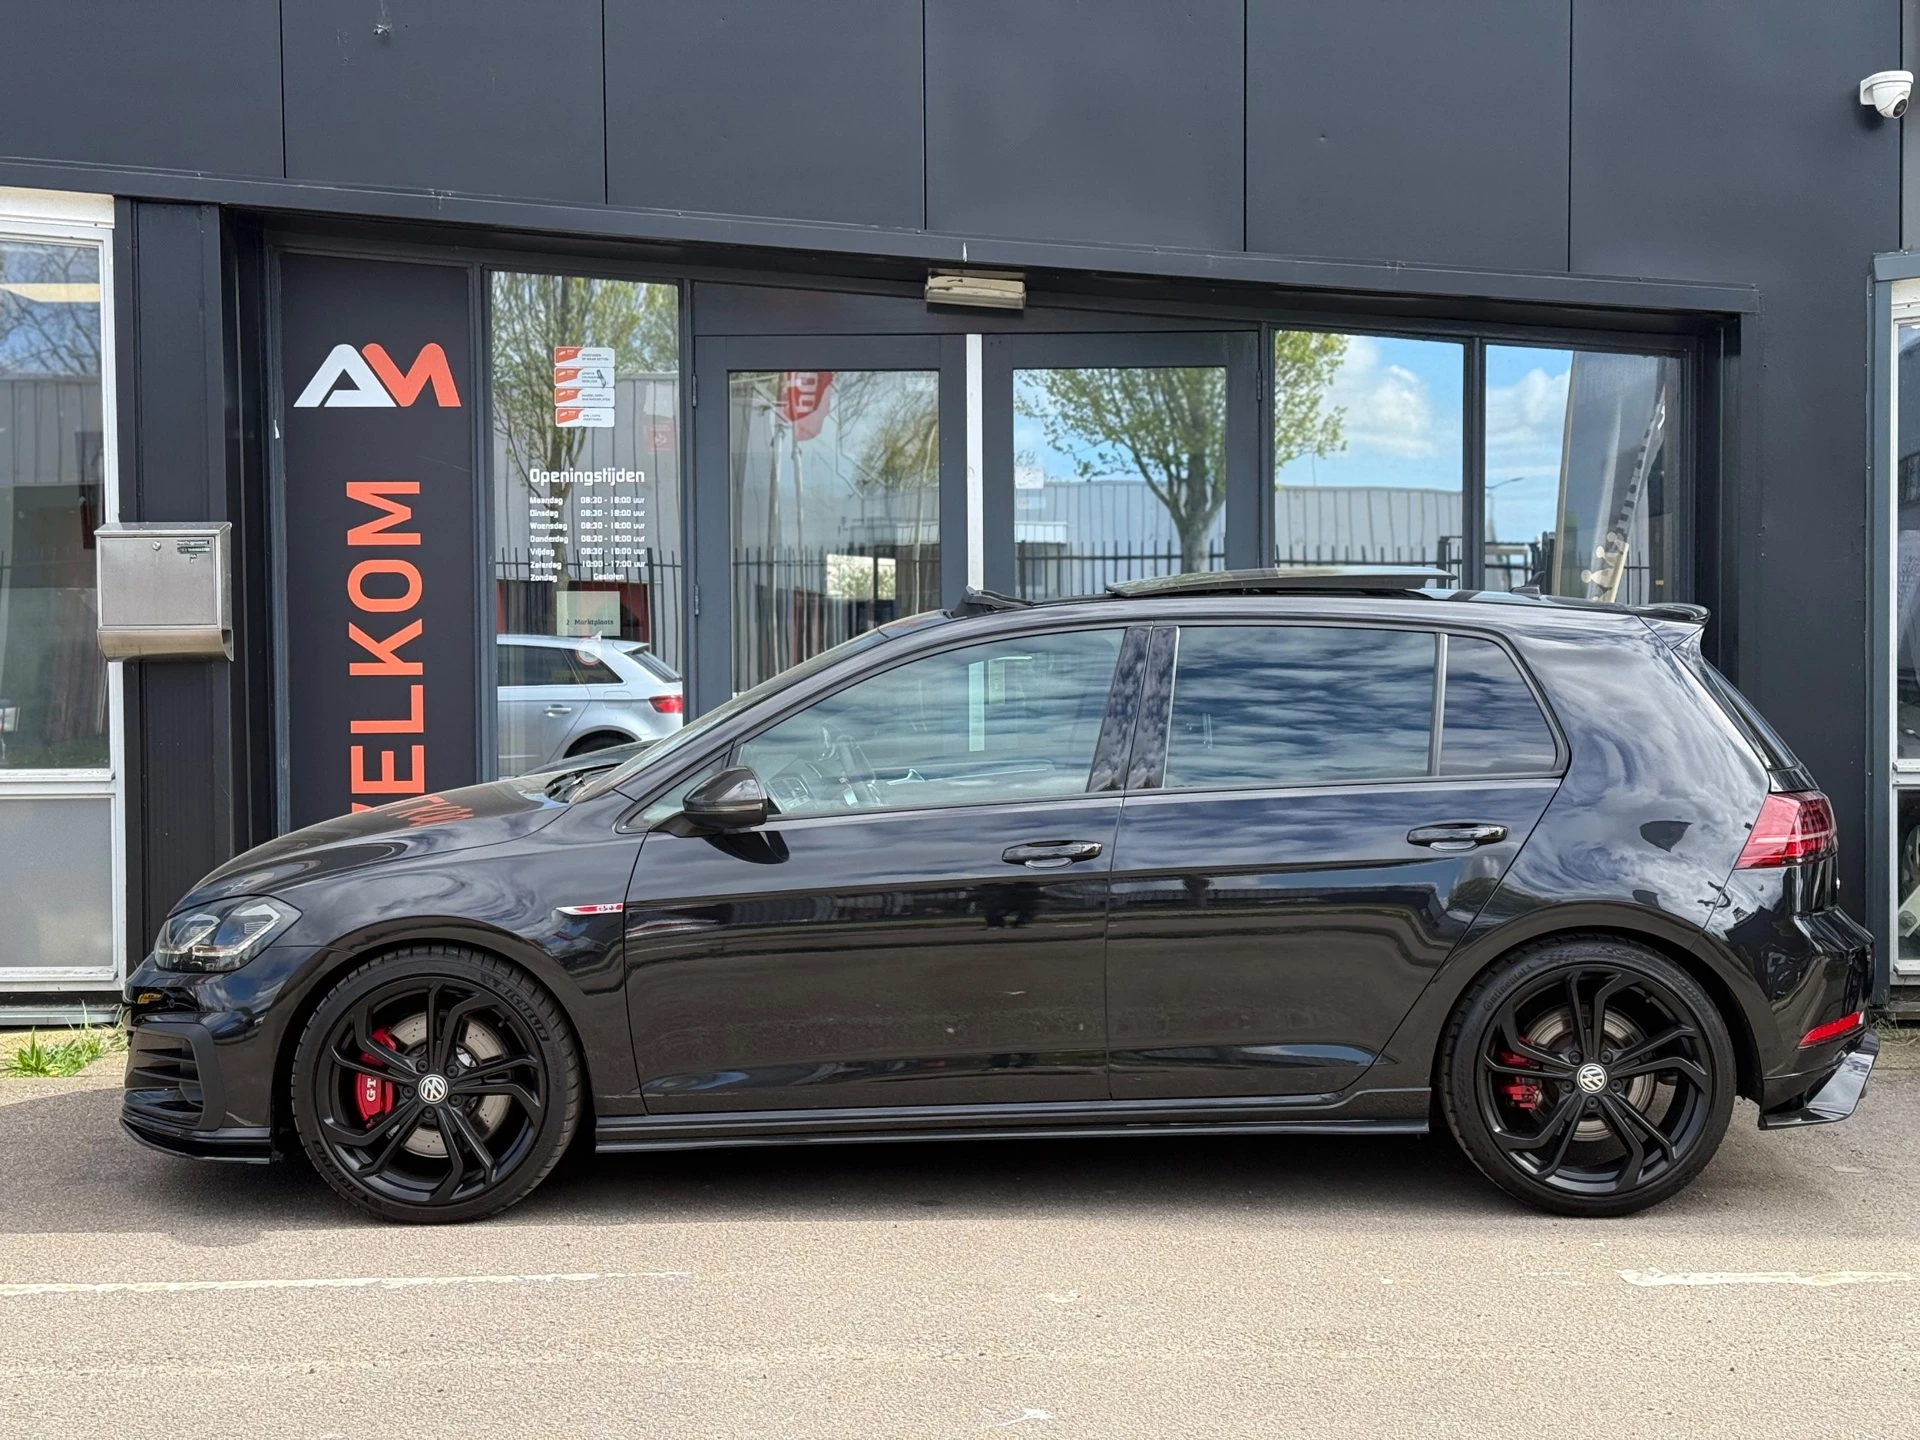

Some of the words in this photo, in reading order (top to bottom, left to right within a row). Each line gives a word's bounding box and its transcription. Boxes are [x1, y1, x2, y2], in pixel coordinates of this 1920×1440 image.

[529, 467, 645, 486] Openingstijden
[529, 497, 564, 505] Maandag
[529, 510, 559, 518] Dinsdag
[529, 522, 568, 531] Woensdag
[529, 535, 569, 544] Donderdag
[529, 548, 555, 557] Vrijdag
[530, 561, 562, 570] Zaterdag
[530, 574, 558, 582] Zondag
[345, 481, 425, 812] ELKOM
[497, 983, 548, 1038] MICHELIN
[366, 1078, 377, 1102] GT
